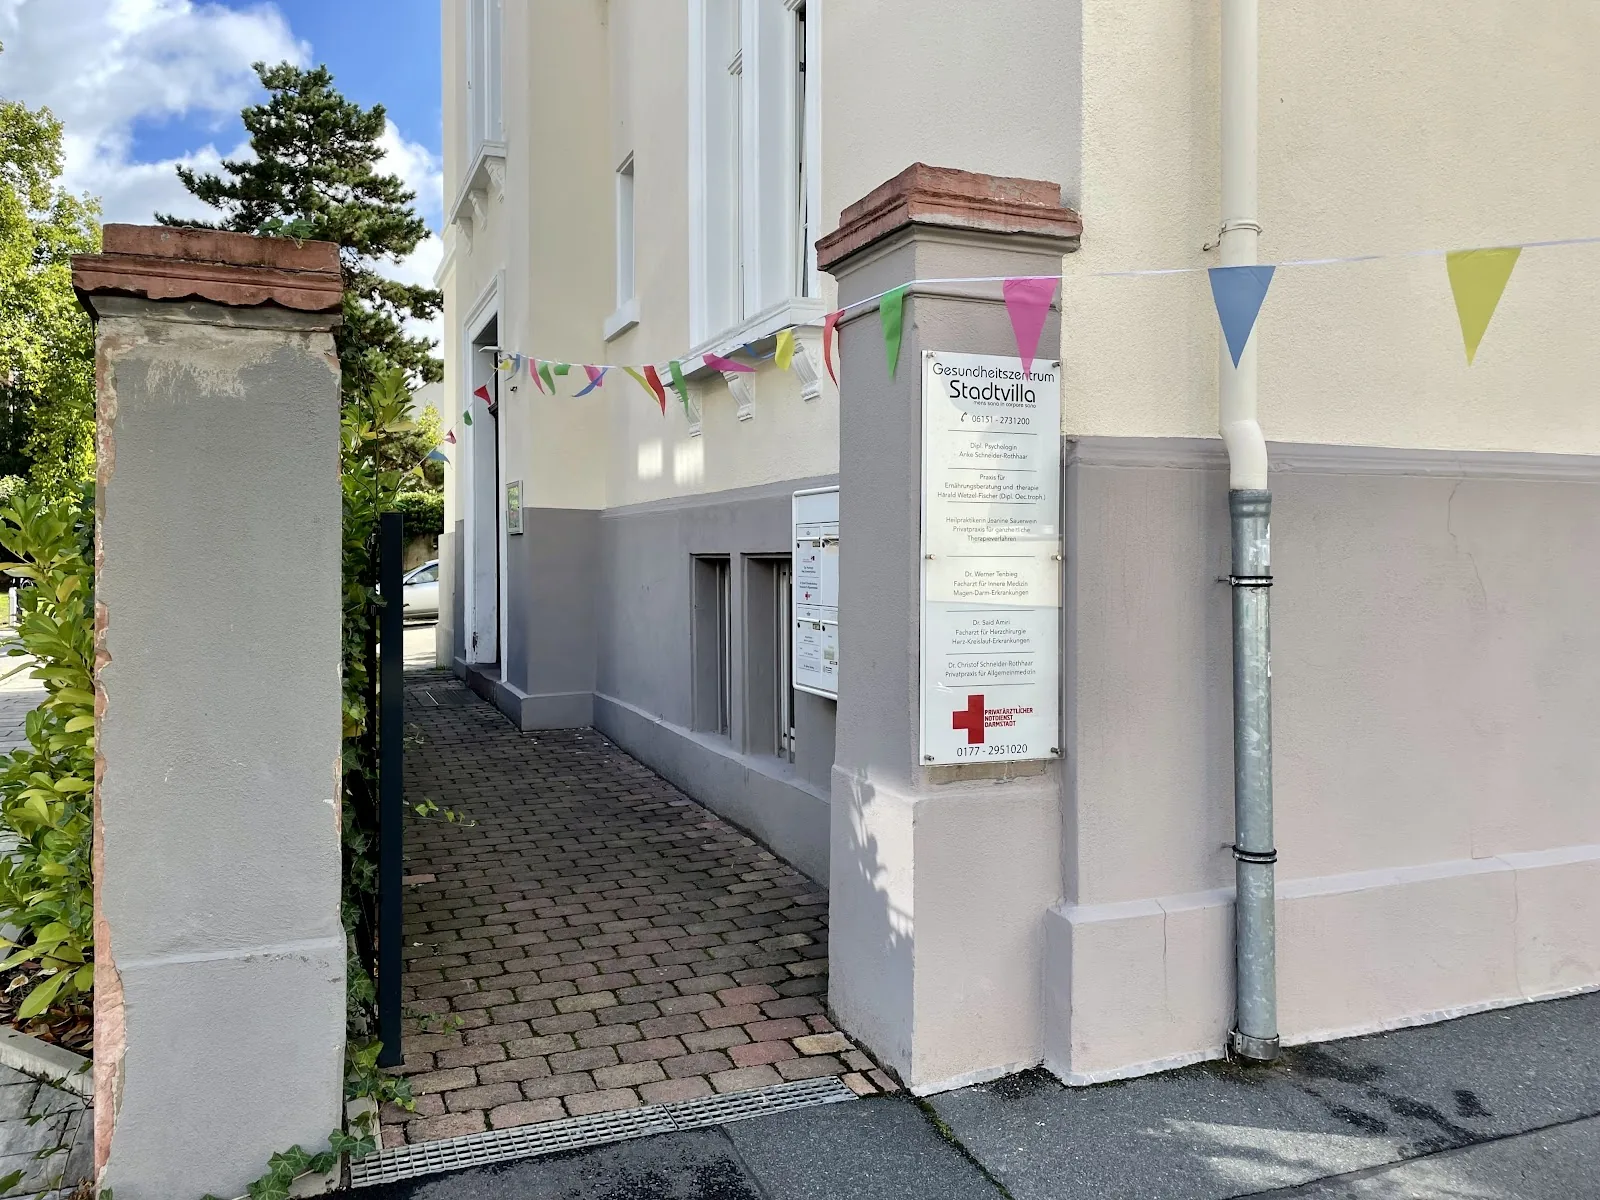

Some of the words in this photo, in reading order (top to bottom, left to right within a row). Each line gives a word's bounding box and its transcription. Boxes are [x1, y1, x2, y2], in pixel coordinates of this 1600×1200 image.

[949, 380, 1036, 403] Stadtvilla
[972, 415, 993, 423] 06151
[1000, 417, 1030, 425] 2731200
[985, 443, 1017, 451] Psychologin
[945, 482, 1001, 491] Ernährungsberatung
[957, 747, 979, 757] 0177
[988, 744, 1028, 755] 2951020
